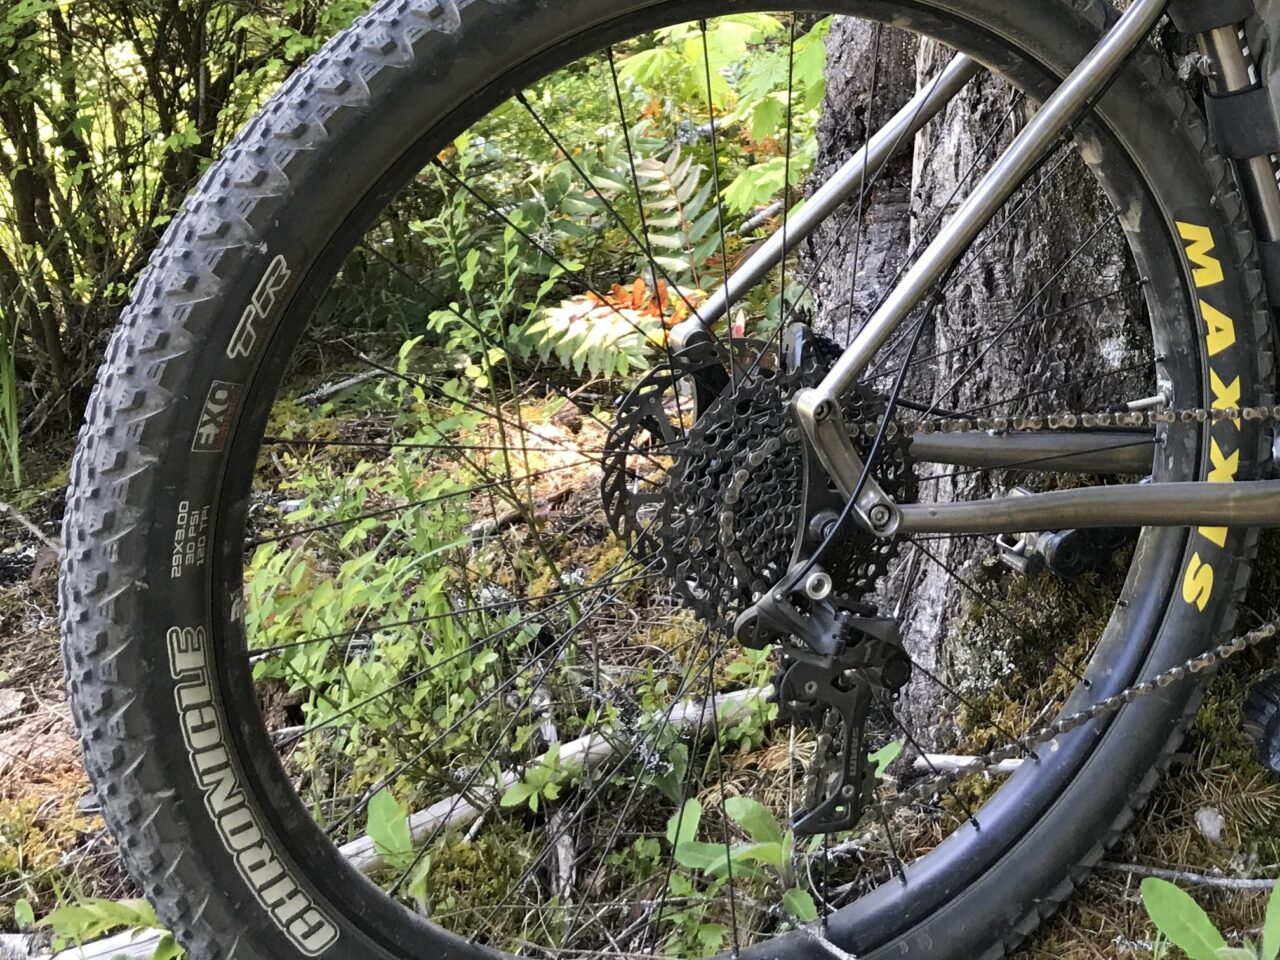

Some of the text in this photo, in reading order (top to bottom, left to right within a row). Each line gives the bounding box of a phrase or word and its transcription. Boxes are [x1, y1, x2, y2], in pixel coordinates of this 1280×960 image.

[226, 254, 292, 359] TR
[171, 501, 189, 578] 29X3.00
[185, 510, 200, 565] 30 PSI
[197, 505, 210, 567] 120 TPI
[166, 626, 340, 957] CHRONICLE
